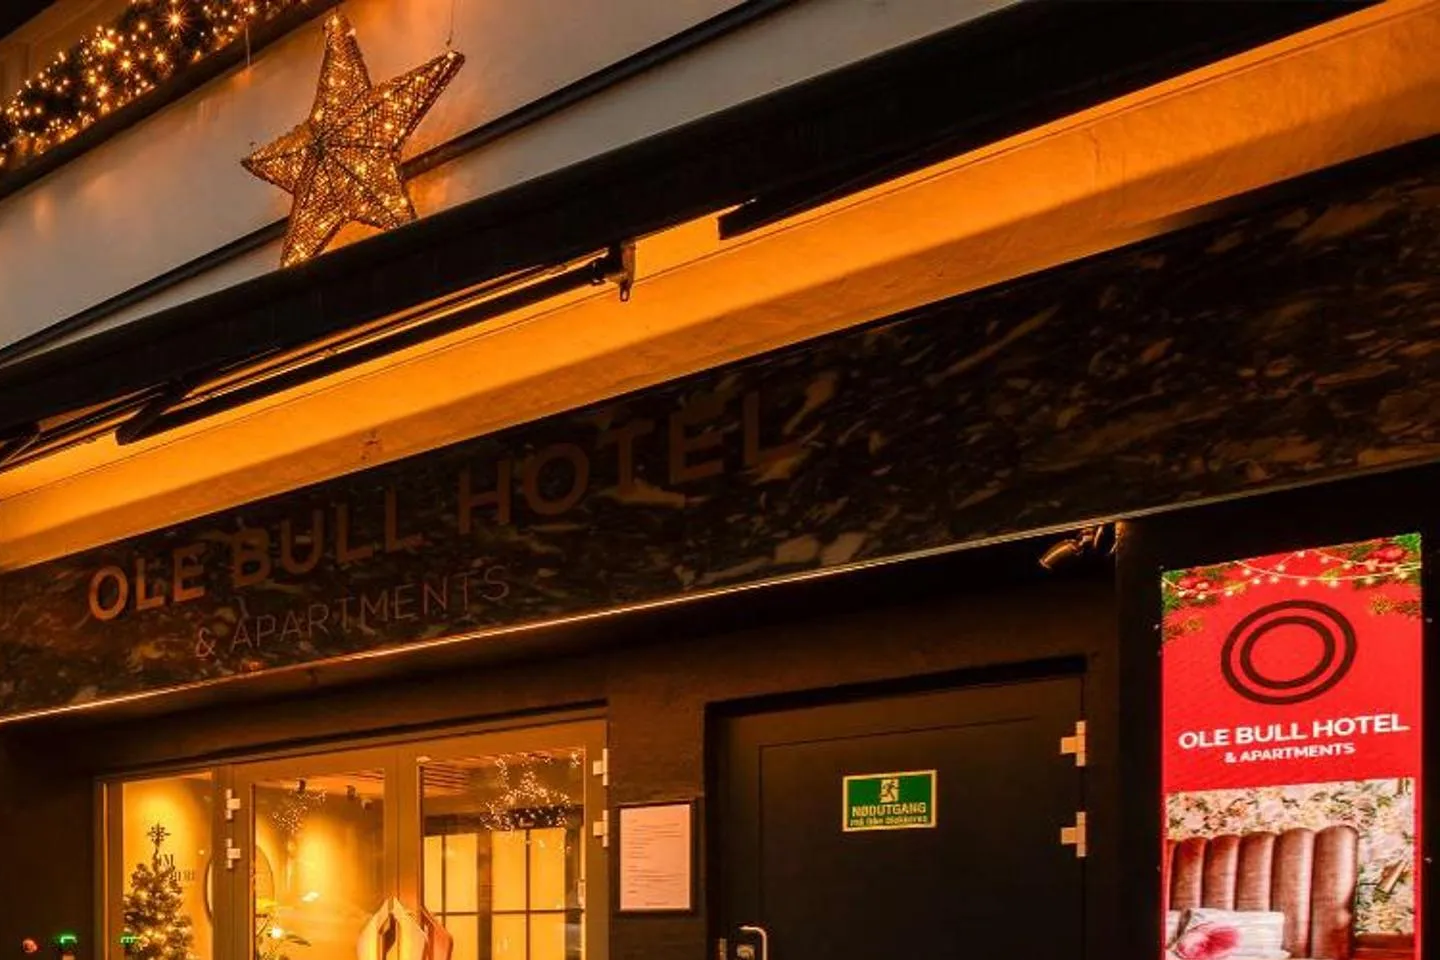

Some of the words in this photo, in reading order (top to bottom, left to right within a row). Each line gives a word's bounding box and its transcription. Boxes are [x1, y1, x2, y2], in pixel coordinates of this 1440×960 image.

[87, 542, 206, 622] OLE
[229, 484, 423, 588] BULL
[457, 390, 806, 536] HOTEL
[195, 626, 216, 659] &
[230, 565, 511, 653] APARTMENTS
[1178, 728, 1231, 750] OLE
[1235, 722, 1308, 745] BULL
[1312, 713, 1411, 739] HOTEL
[1224, 751, 1237, 764] &
[1240, 742, 1357, 763] APARTMENTS
[851, 802, 927, 817] NØDUTGANG
